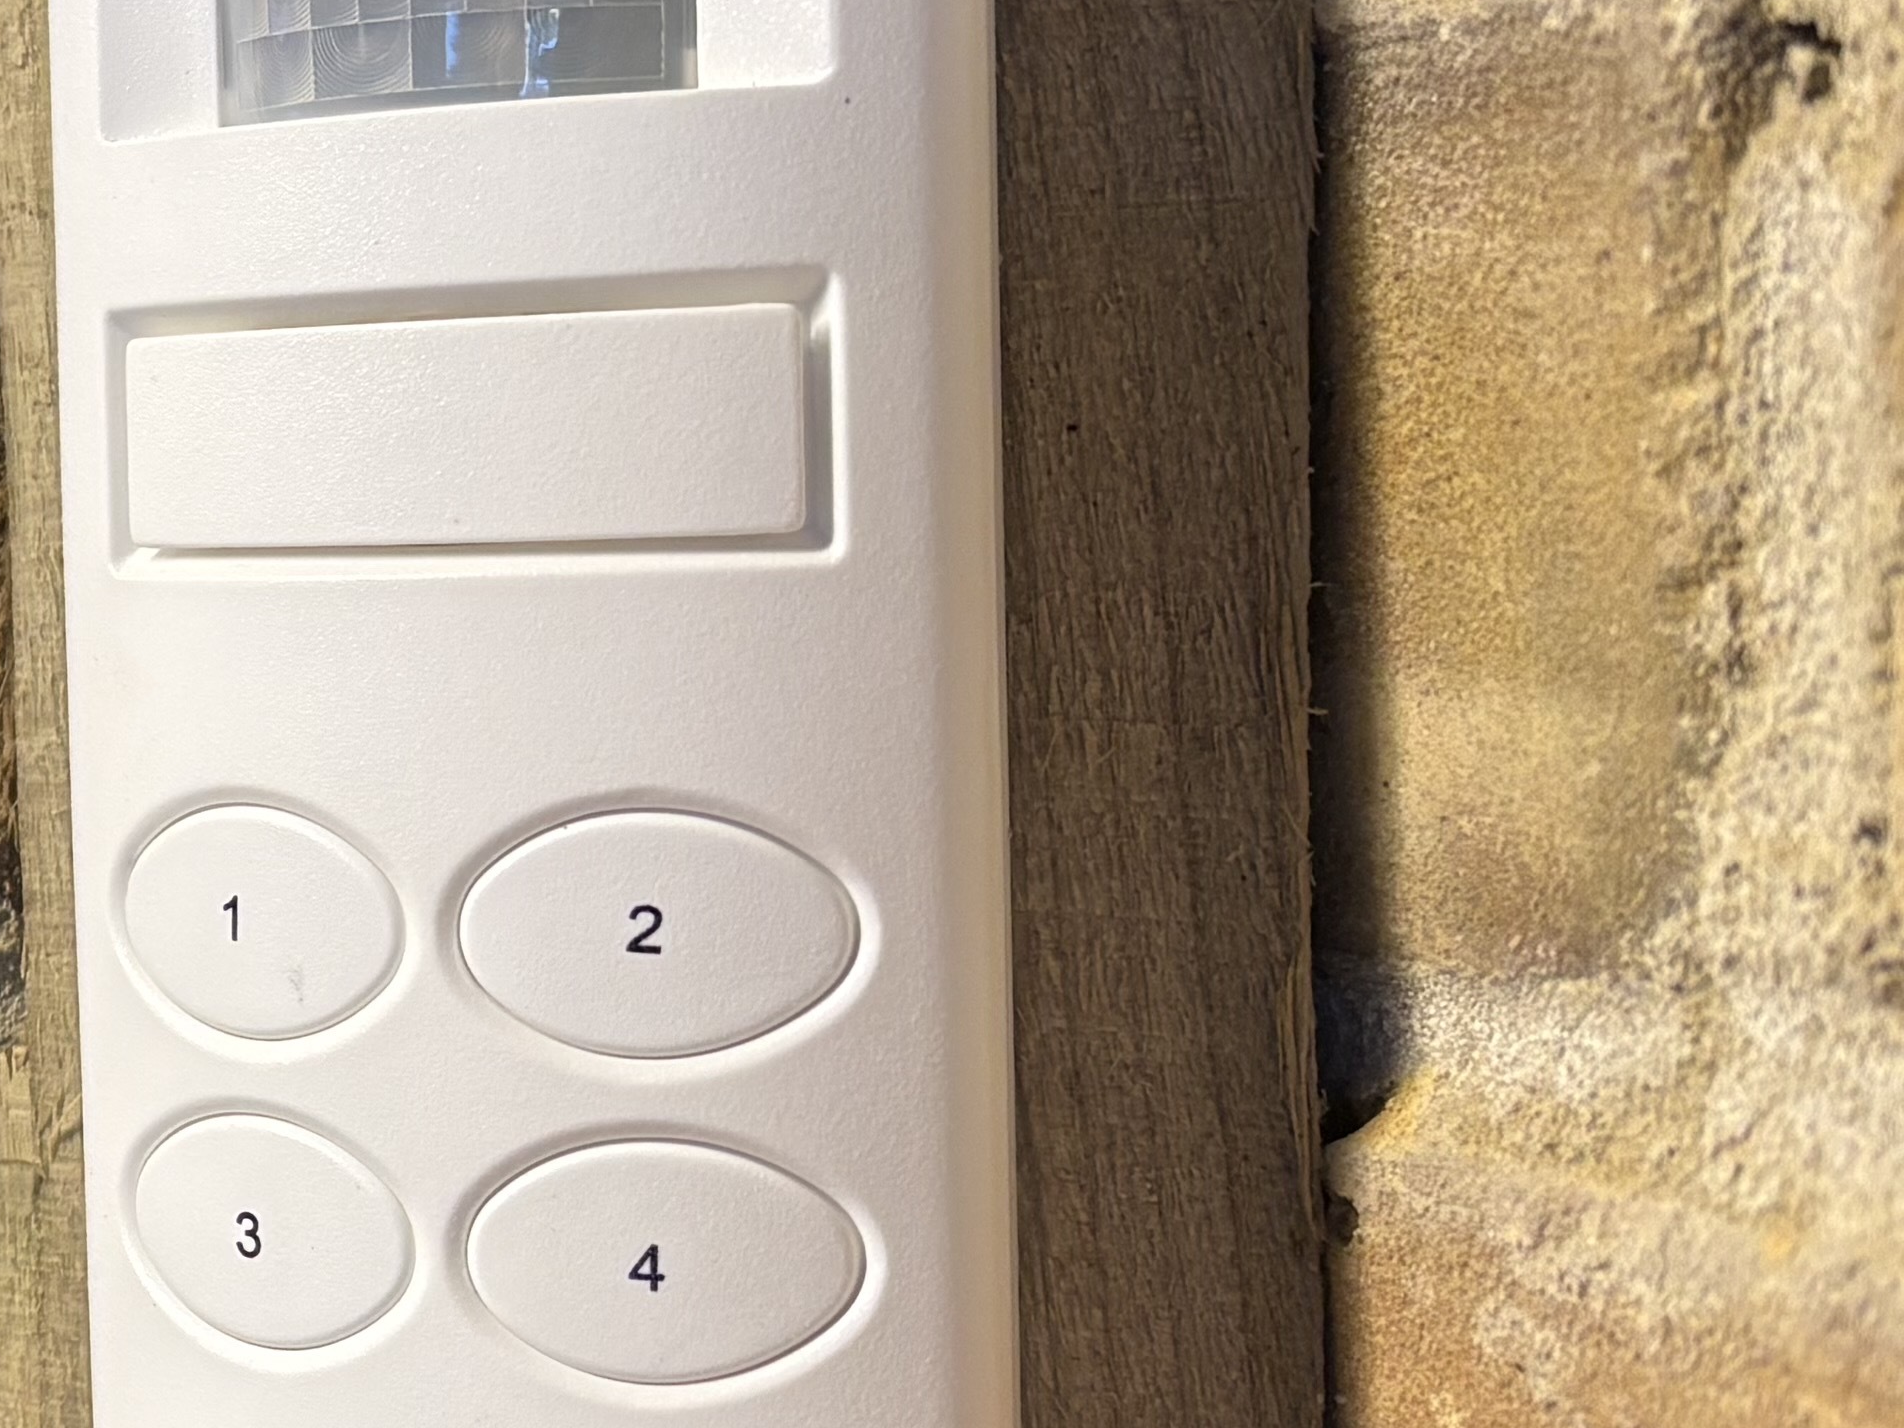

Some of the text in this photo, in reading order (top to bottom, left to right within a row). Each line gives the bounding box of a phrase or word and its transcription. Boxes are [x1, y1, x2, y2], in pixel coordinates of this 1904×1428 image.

[221, 894, 239, 943] 1
[625, 904, 664, 956] 2
[235, 1210, 263, 1260] 3
[627, 1243, 667, 1294] 4
